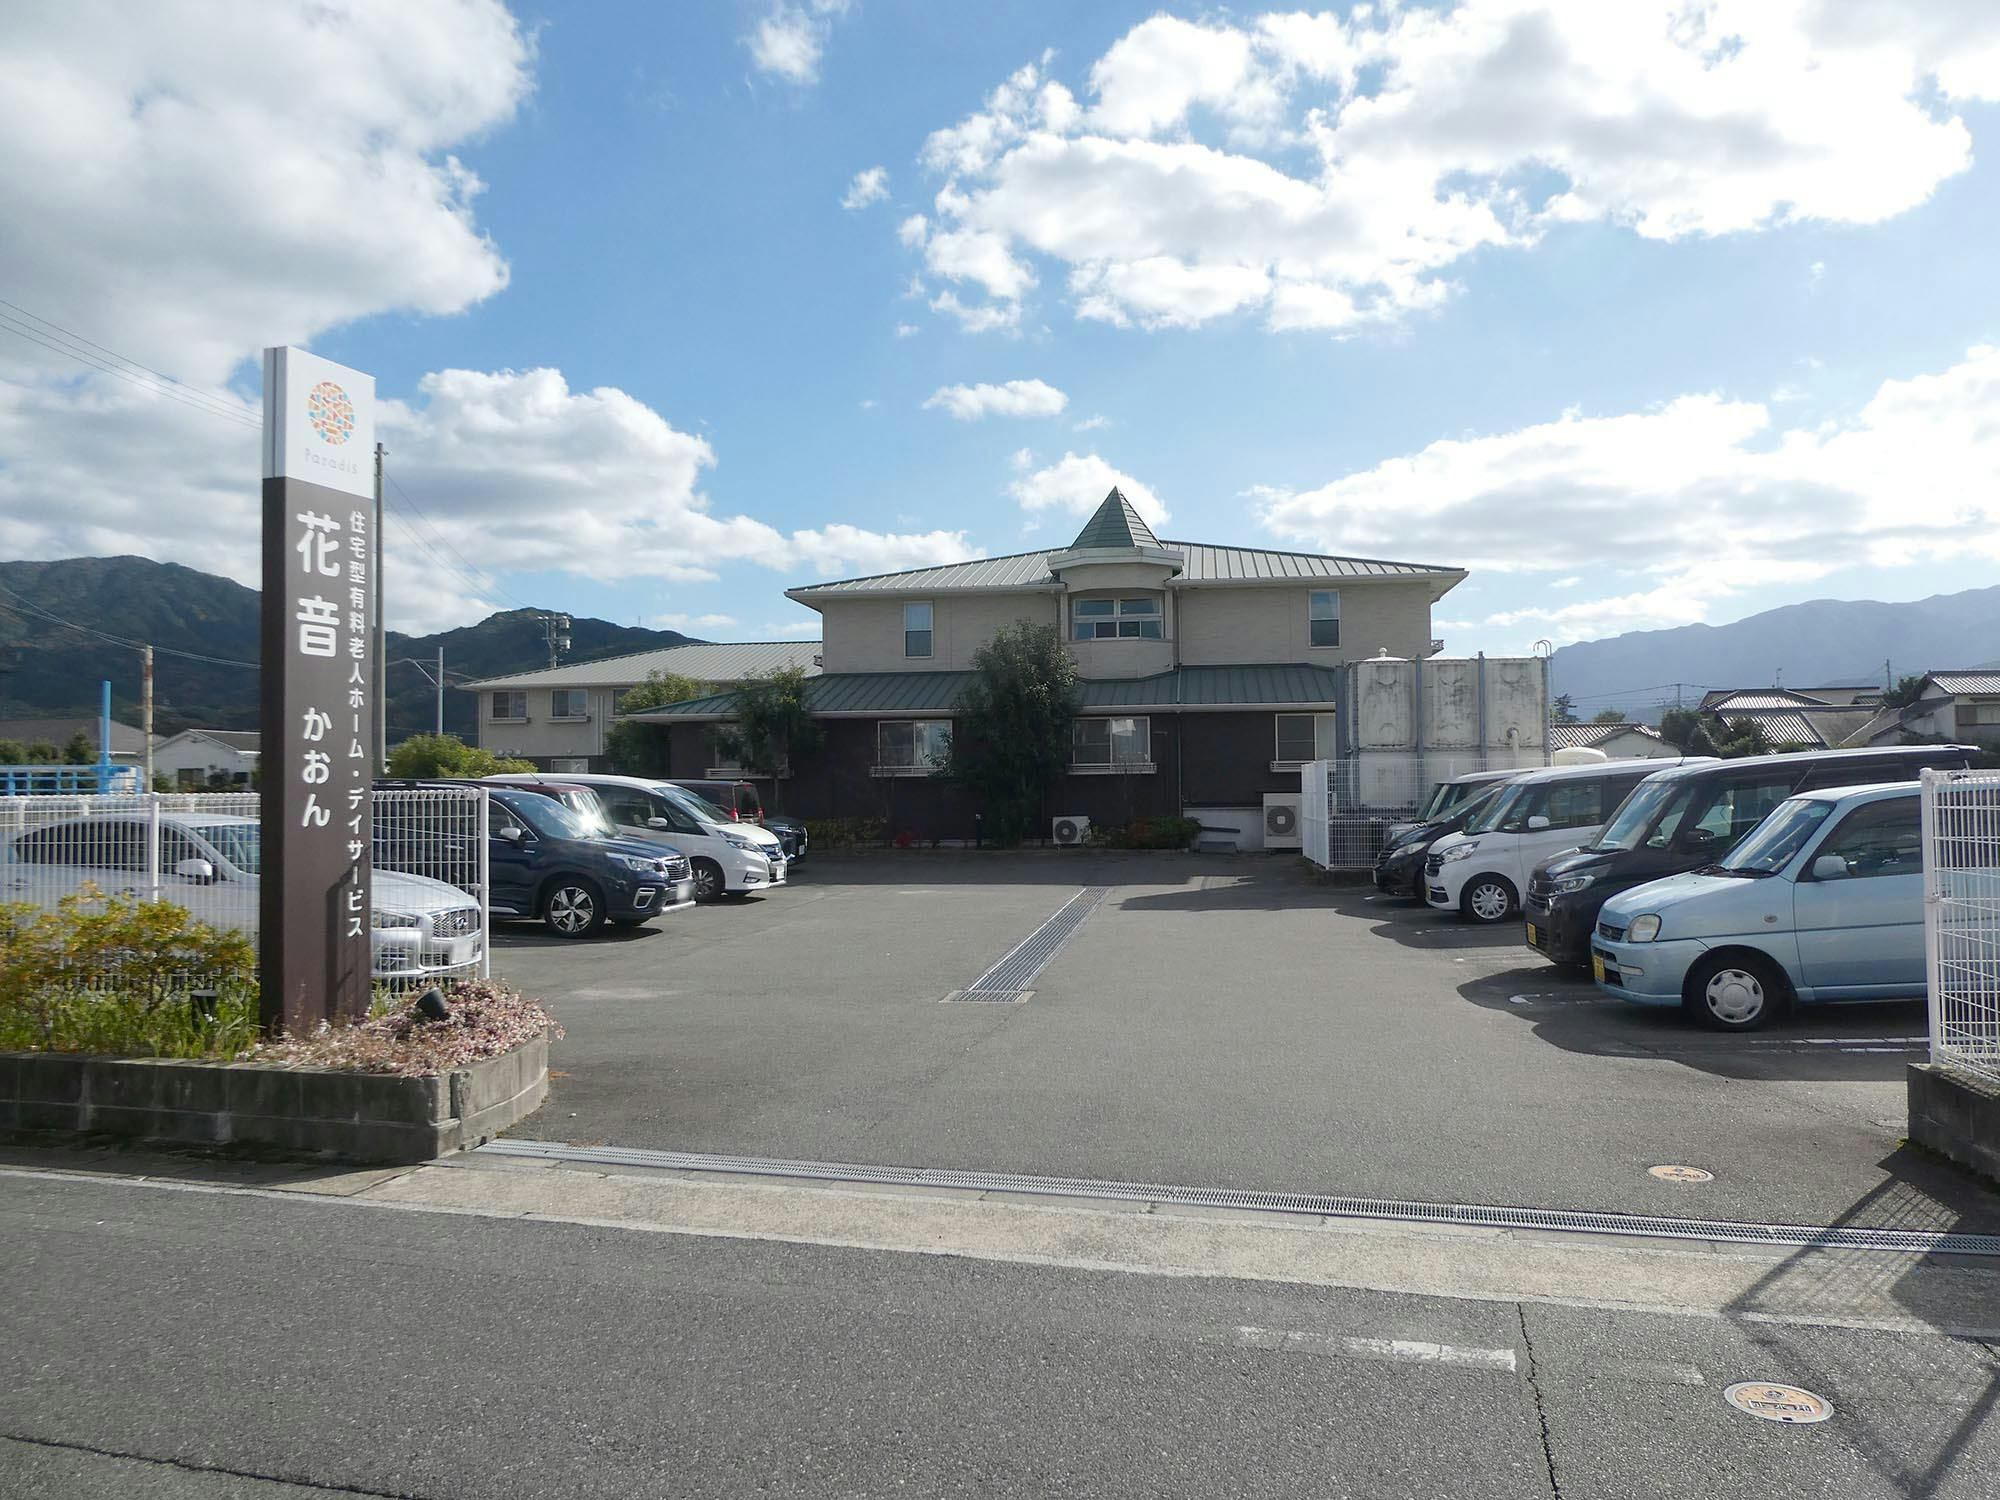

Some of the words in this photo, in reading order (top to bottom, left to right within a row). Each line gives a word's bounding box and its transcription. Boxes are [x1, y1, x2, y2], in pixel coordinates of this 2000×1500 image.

[296, 510, 341, 658] 花音
[302, 707, 332, 827] かおん
